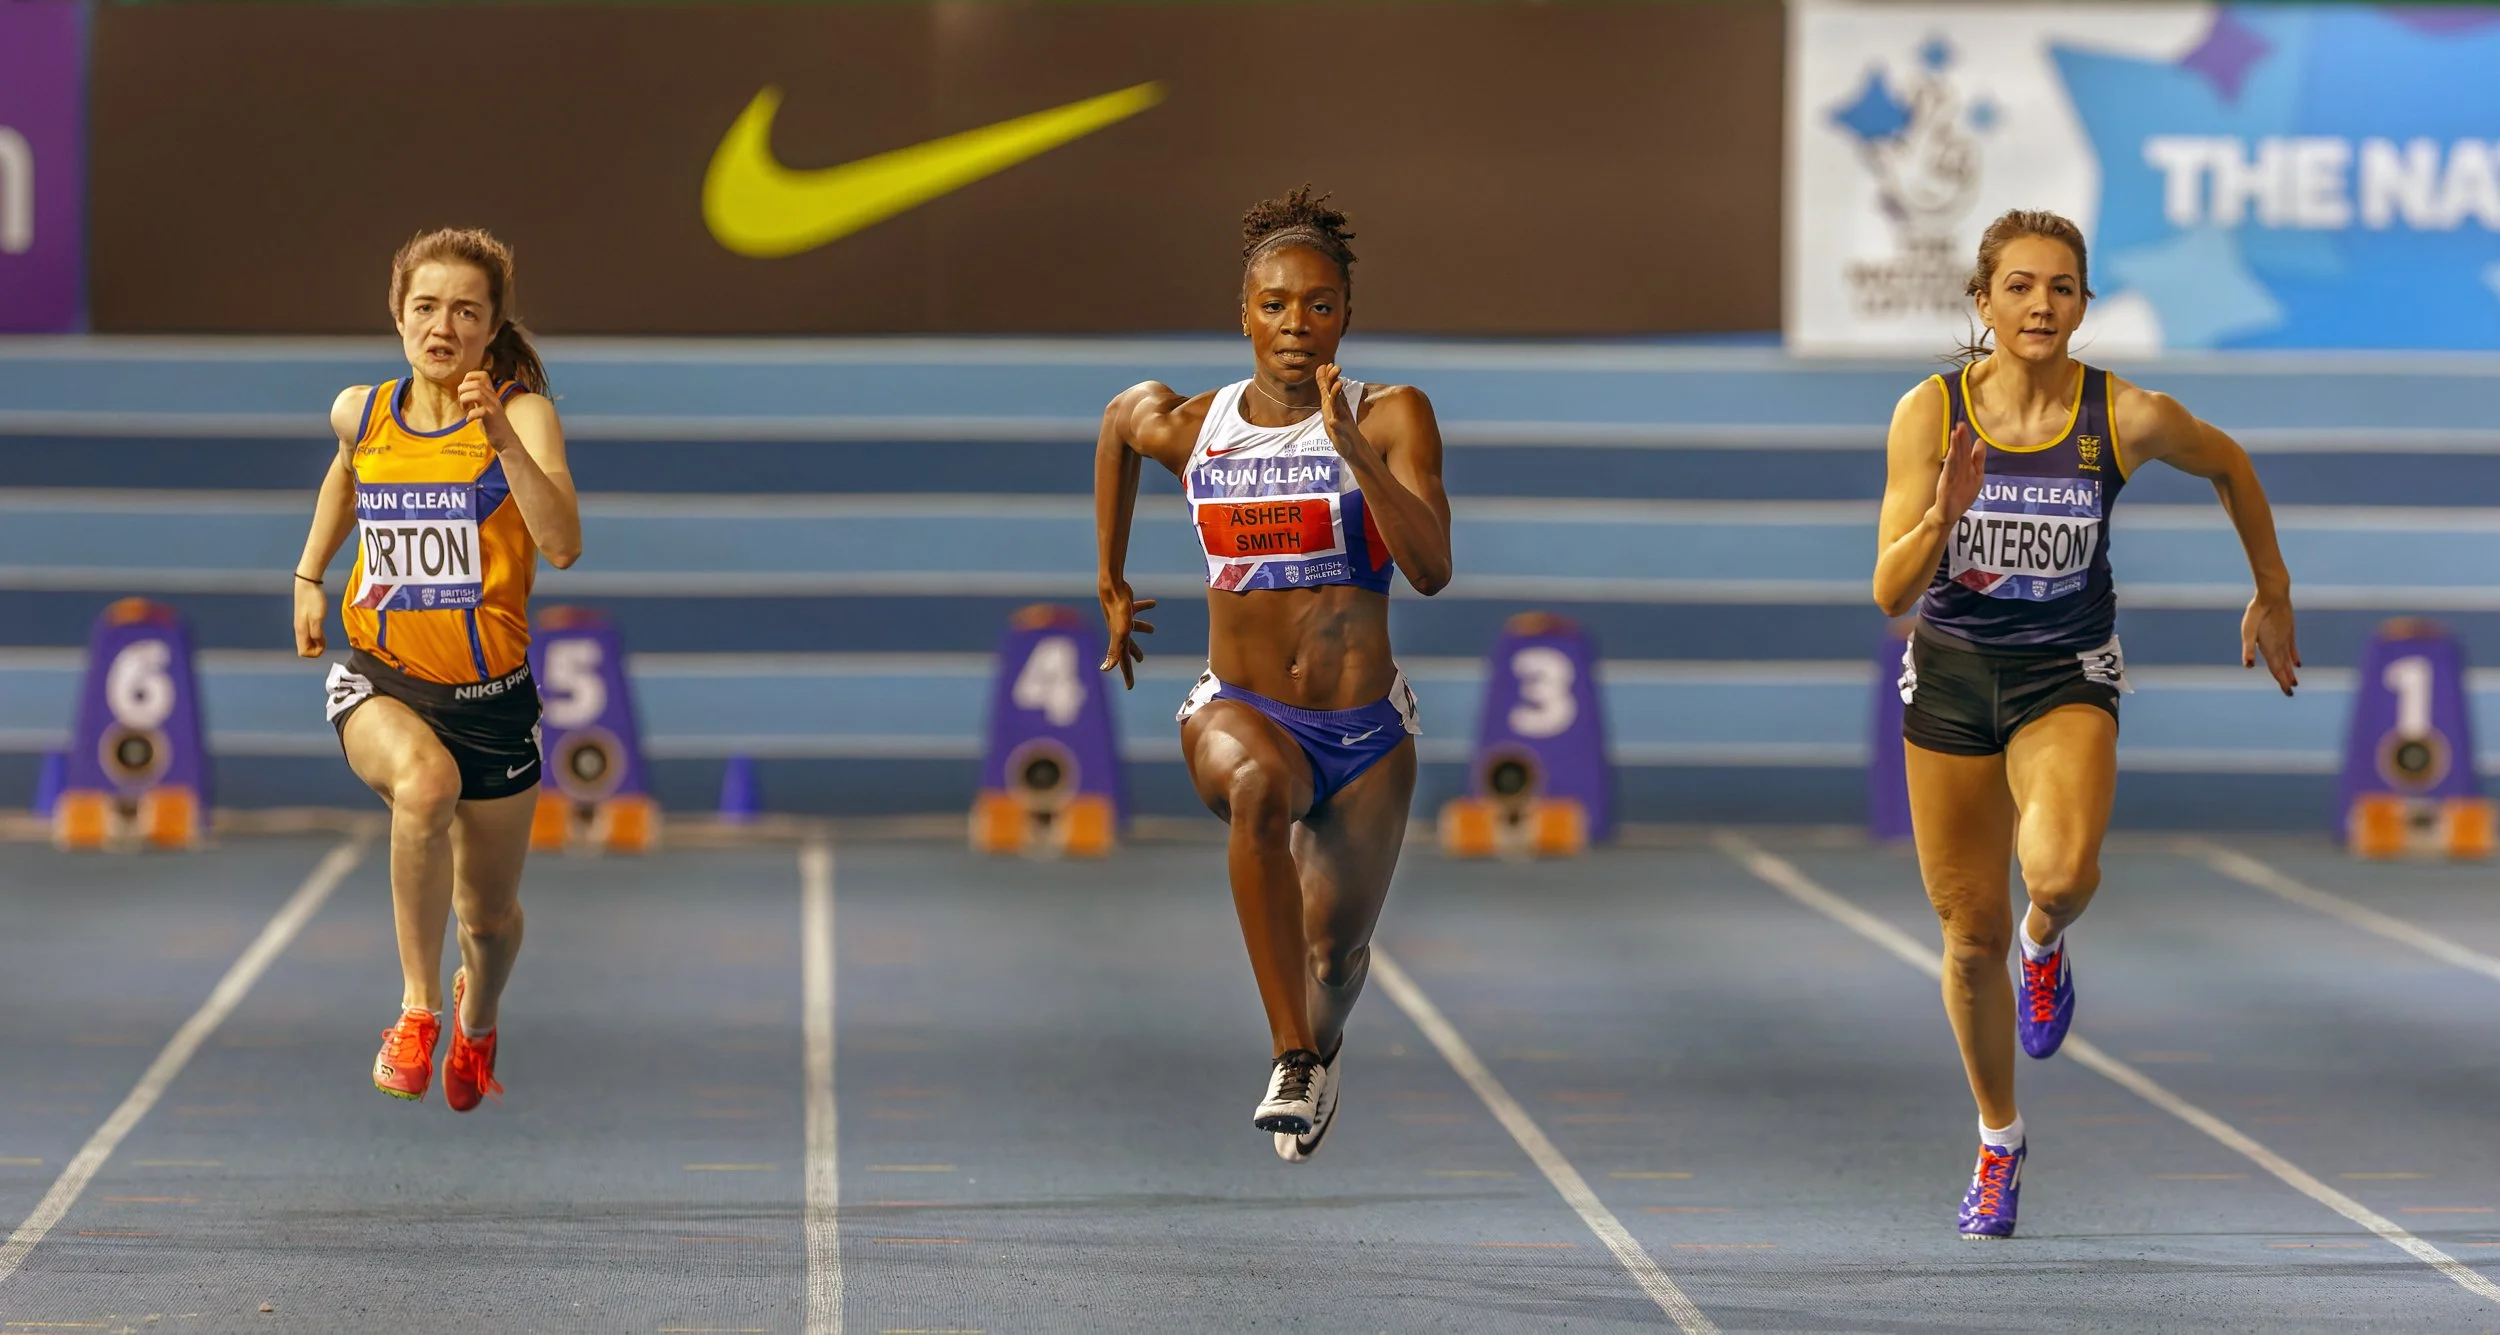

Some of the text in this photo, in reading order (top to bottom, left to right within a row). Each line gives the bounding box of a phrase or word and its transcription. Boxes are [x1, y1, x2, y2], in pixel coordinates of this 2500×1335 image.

[2146, 136, 2500, 230] THE NA
[1200, 465, 1331, 486] I RUN CLEAN
[361, 492, 398, 510] RUN
[402, 491, 466, 510] CLEAN
[2023, 487, 2093, 507] CLEAN
[1231, 506, 1303, 526] ASHER
[365, 526, 470, 577] ORTON
[1236, 532, 1301, 551] SMITH
[1957, 516, 2088, 571] PATERSON
[1304, 561, 1342, 575] BRITISH
[1305, 569, 1342, 581] ATHLETICS
[440, 588, 475, 598] BRITISH
[107, 638, 176, 730] 6
[455, 680, 504, 700] NIKE
[542, 638, 607, 729] 5
[1012, 635, 1087, 728] 4
[1507, 646, 1577, 738] 3
[2381, 654, 2434, 738] 1
